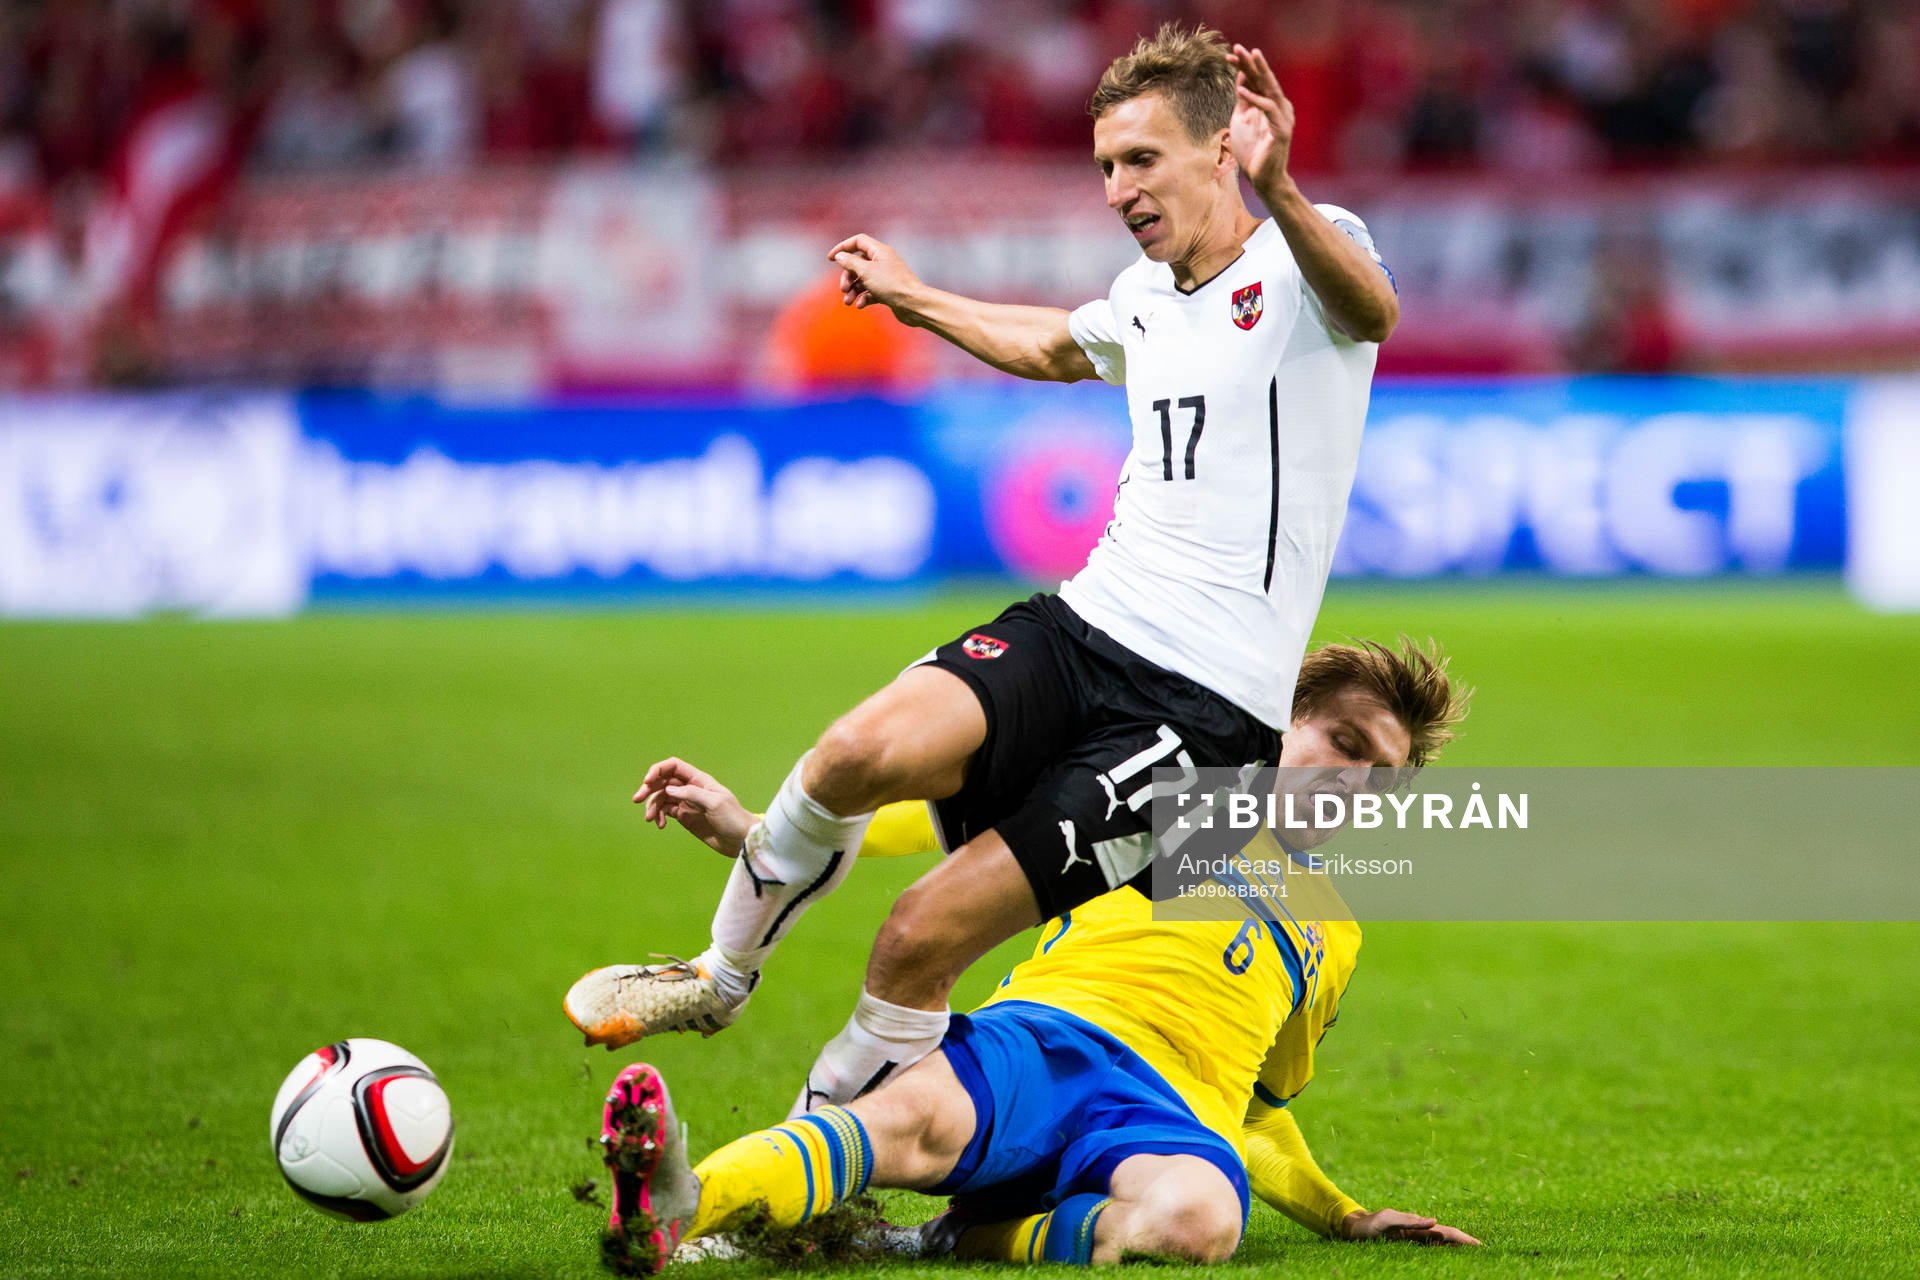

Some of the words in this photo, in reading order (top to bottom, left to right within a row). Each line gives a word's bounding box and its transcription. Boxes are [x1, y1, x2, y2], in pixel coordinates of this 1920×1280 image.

[1152, 394, 1206, 482] 17
[1107, 723, 1199, 813] 17
[1222, 917, 1263, 976] 6
